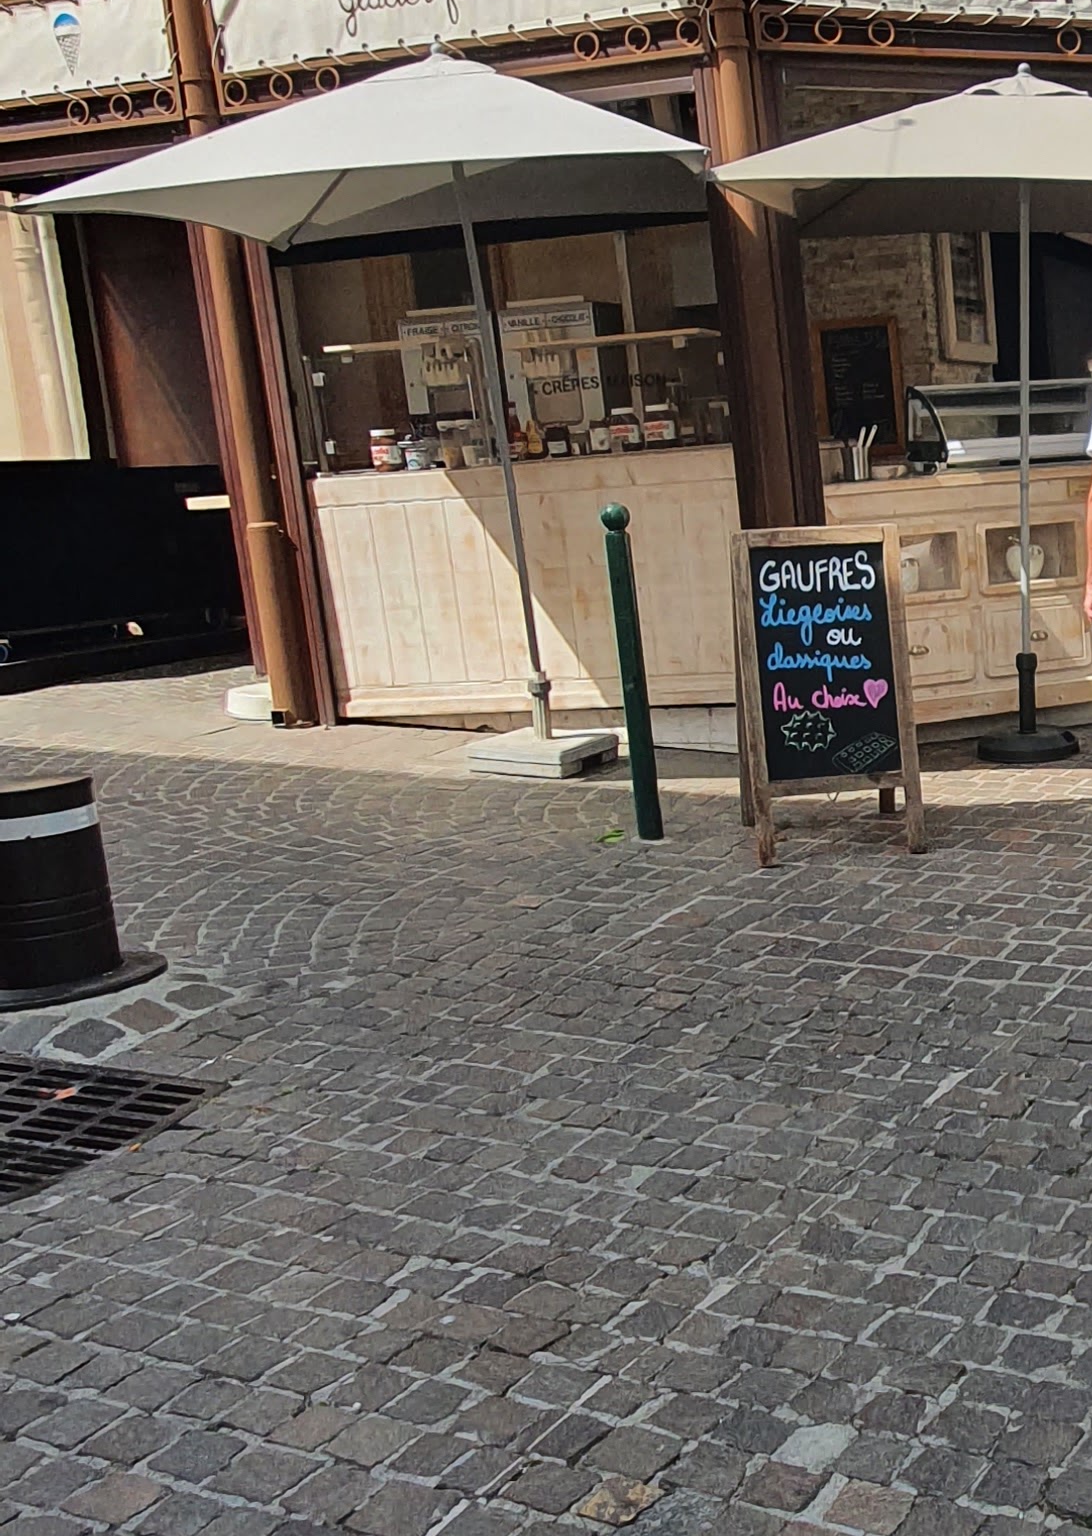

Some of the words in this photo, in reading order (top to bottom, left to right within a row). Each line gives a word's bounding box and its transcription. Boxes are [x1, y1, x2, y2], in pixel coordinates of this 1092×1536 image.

[407, 326, 438, 337] FRAISE
[507, 318, 541, 328] VANILLE
[759, 550, 876, 592] GAUFRES
[759, 593, 873, 646] Liegeoises
[826, 628, 862, 646] ou
[767, 642, 872, 683] classiques
[773, 681, 804, 712] Au
[811, 684, 867, 709] choix
